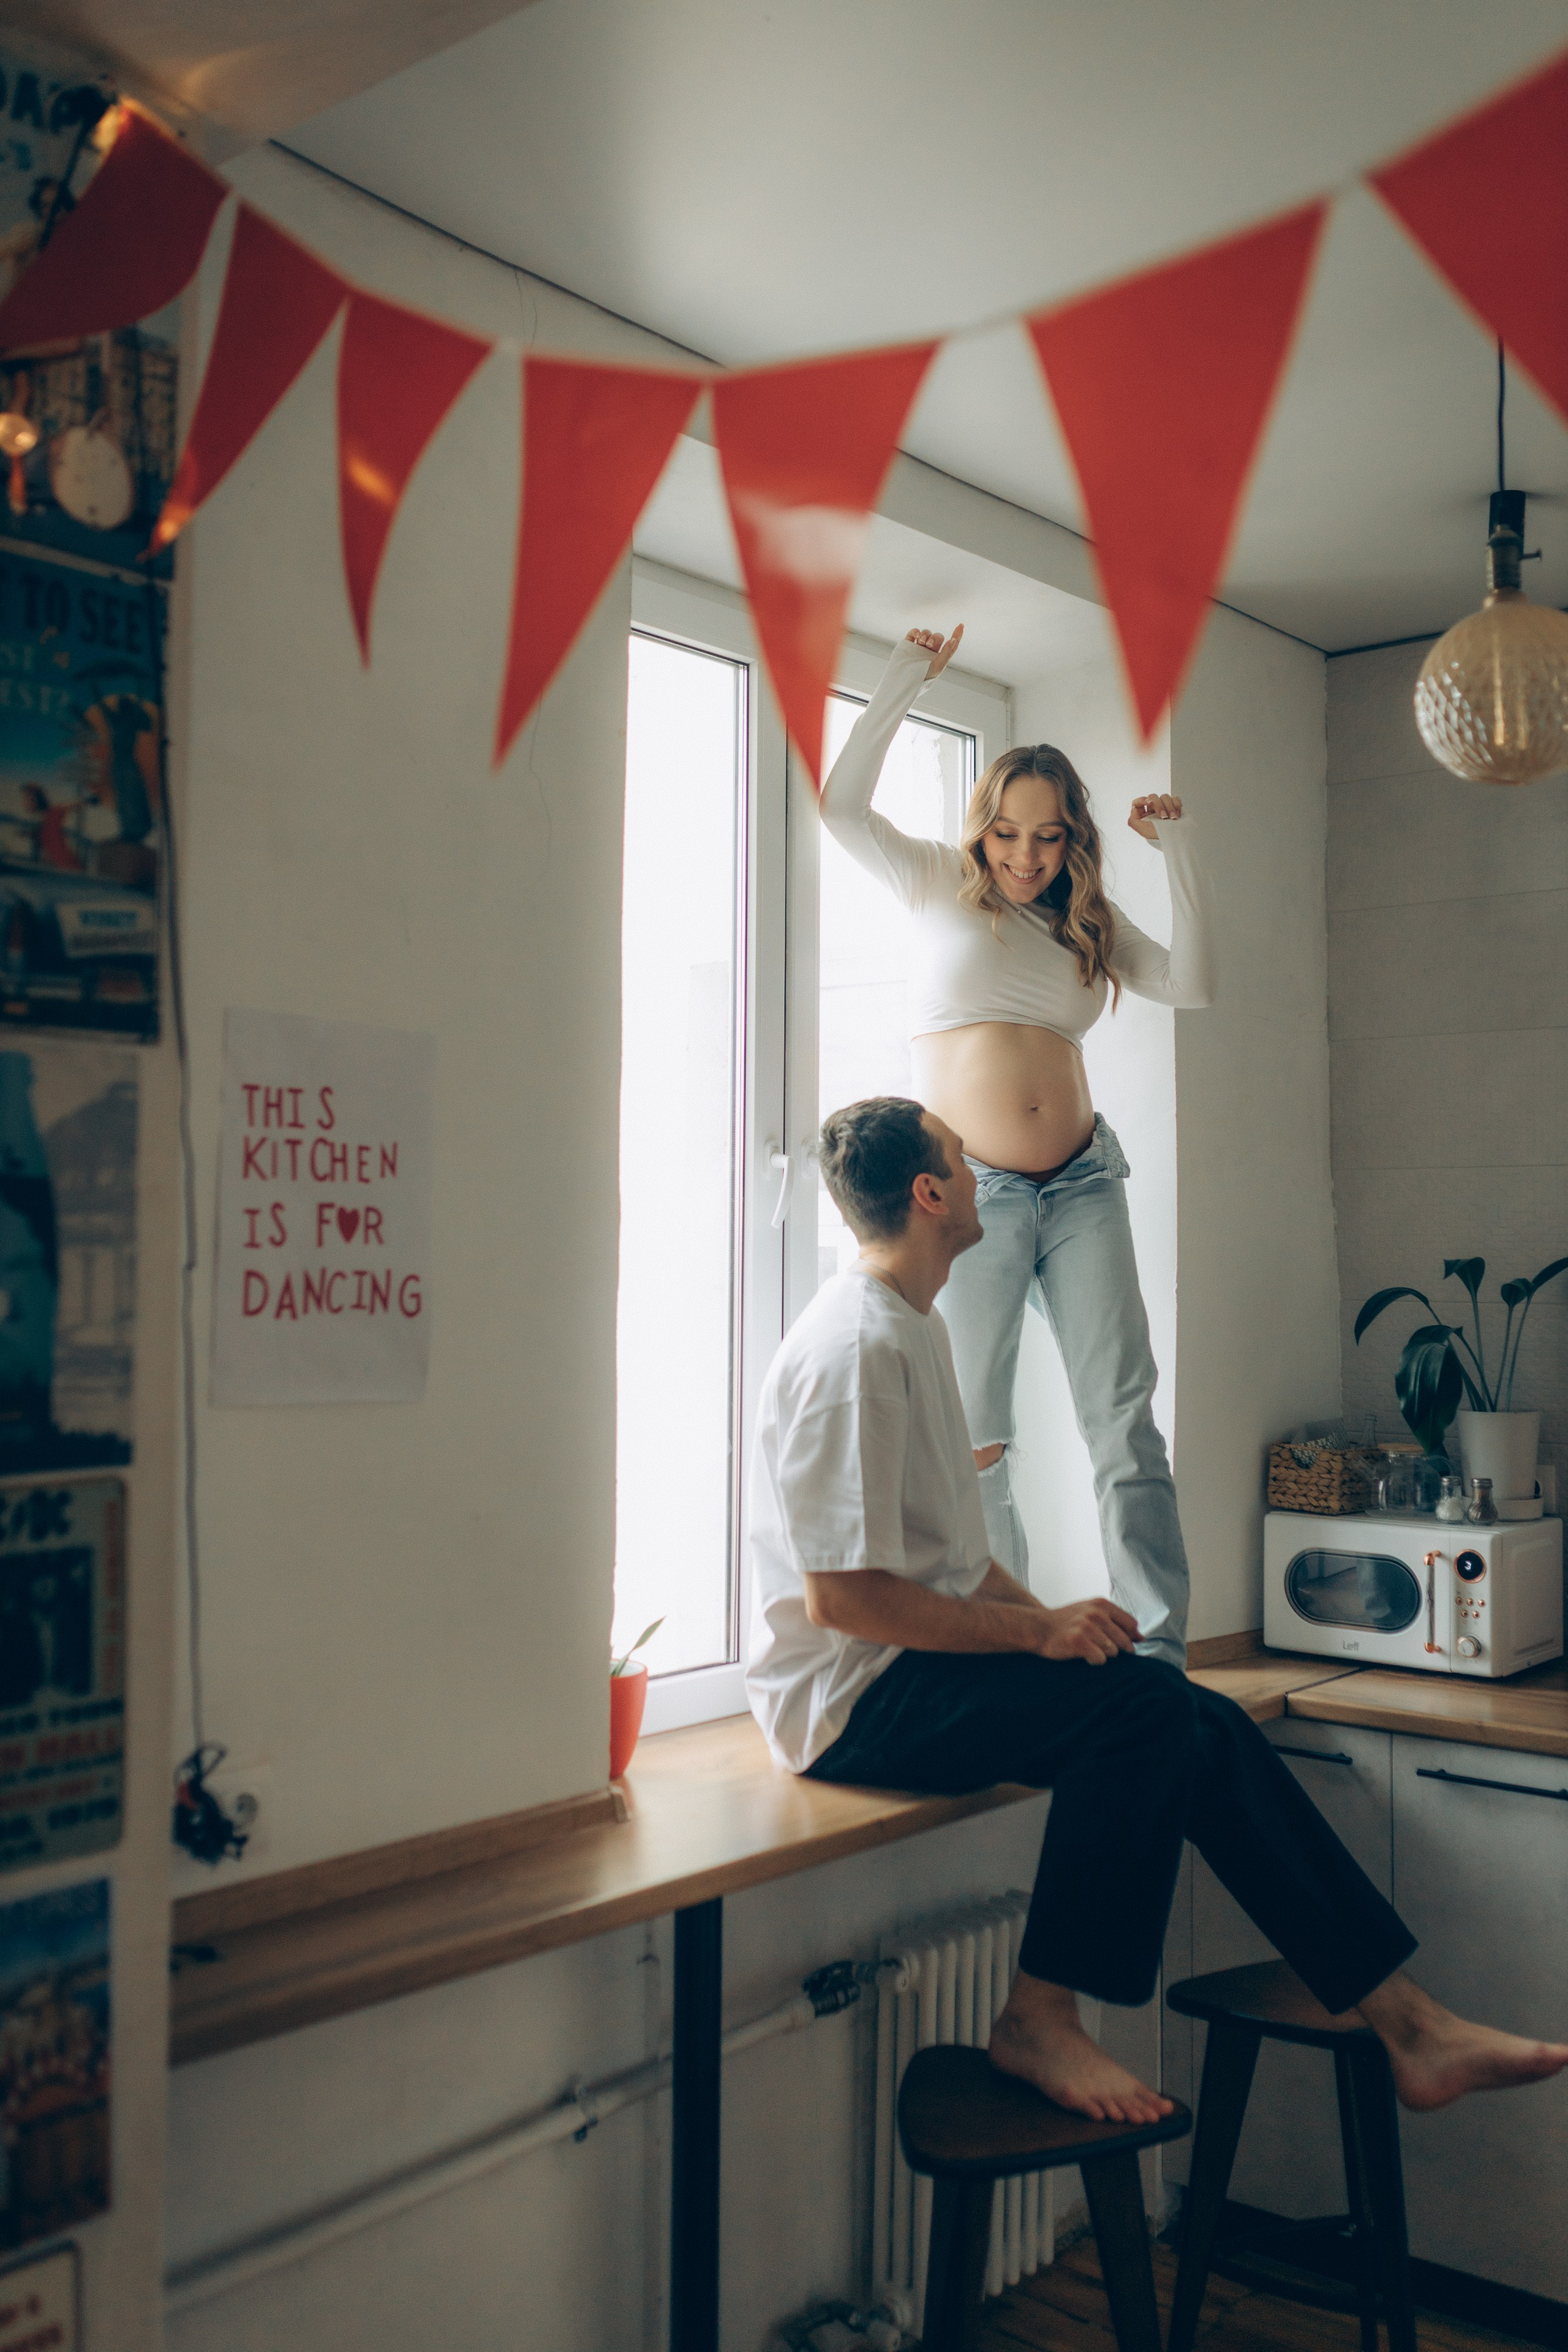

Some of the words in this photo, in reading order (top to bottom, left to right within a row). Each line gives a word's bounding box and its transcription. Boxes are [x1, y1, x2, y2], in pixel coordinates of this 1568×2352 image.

[21, 573, 70, 633] TO
[79, 587, 143, 653] SEE
[241, 1082, 336, 1131] THIS
[242, 1135, 399, 1185] KITCHEN
[243, 1201, 287, 1250] IS
[241, 1267, 422, 1321] DANCING
